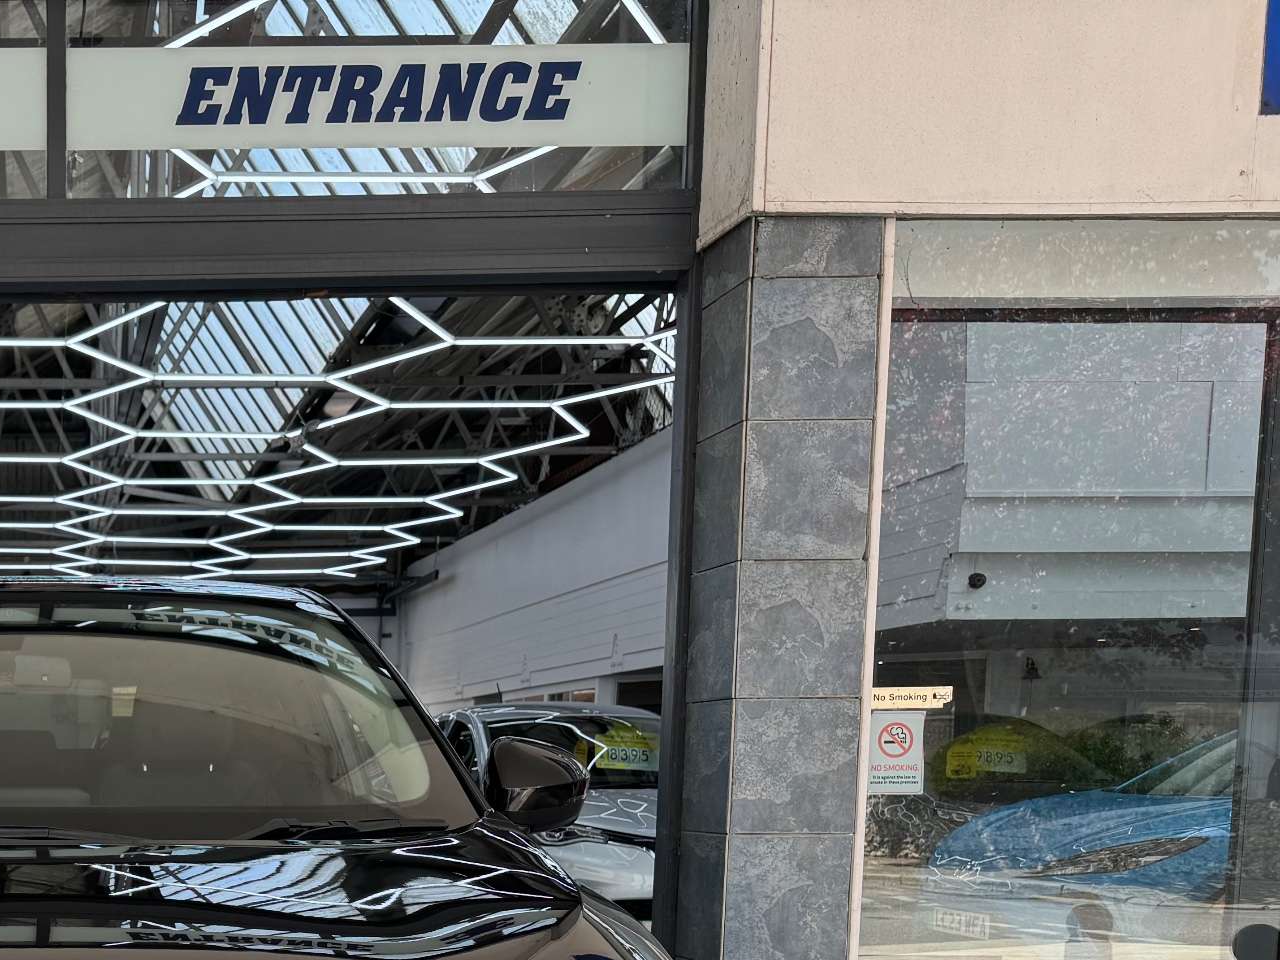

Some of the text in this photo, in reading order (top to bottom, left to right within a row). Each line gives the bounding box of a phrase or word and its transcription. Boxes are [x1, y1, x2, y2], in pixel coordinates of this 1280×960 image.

[175, 60, 583, 126] ENTRANCE
[873, 693, 928, 702] No Smoking
[871, 763, 882, 772] NO
